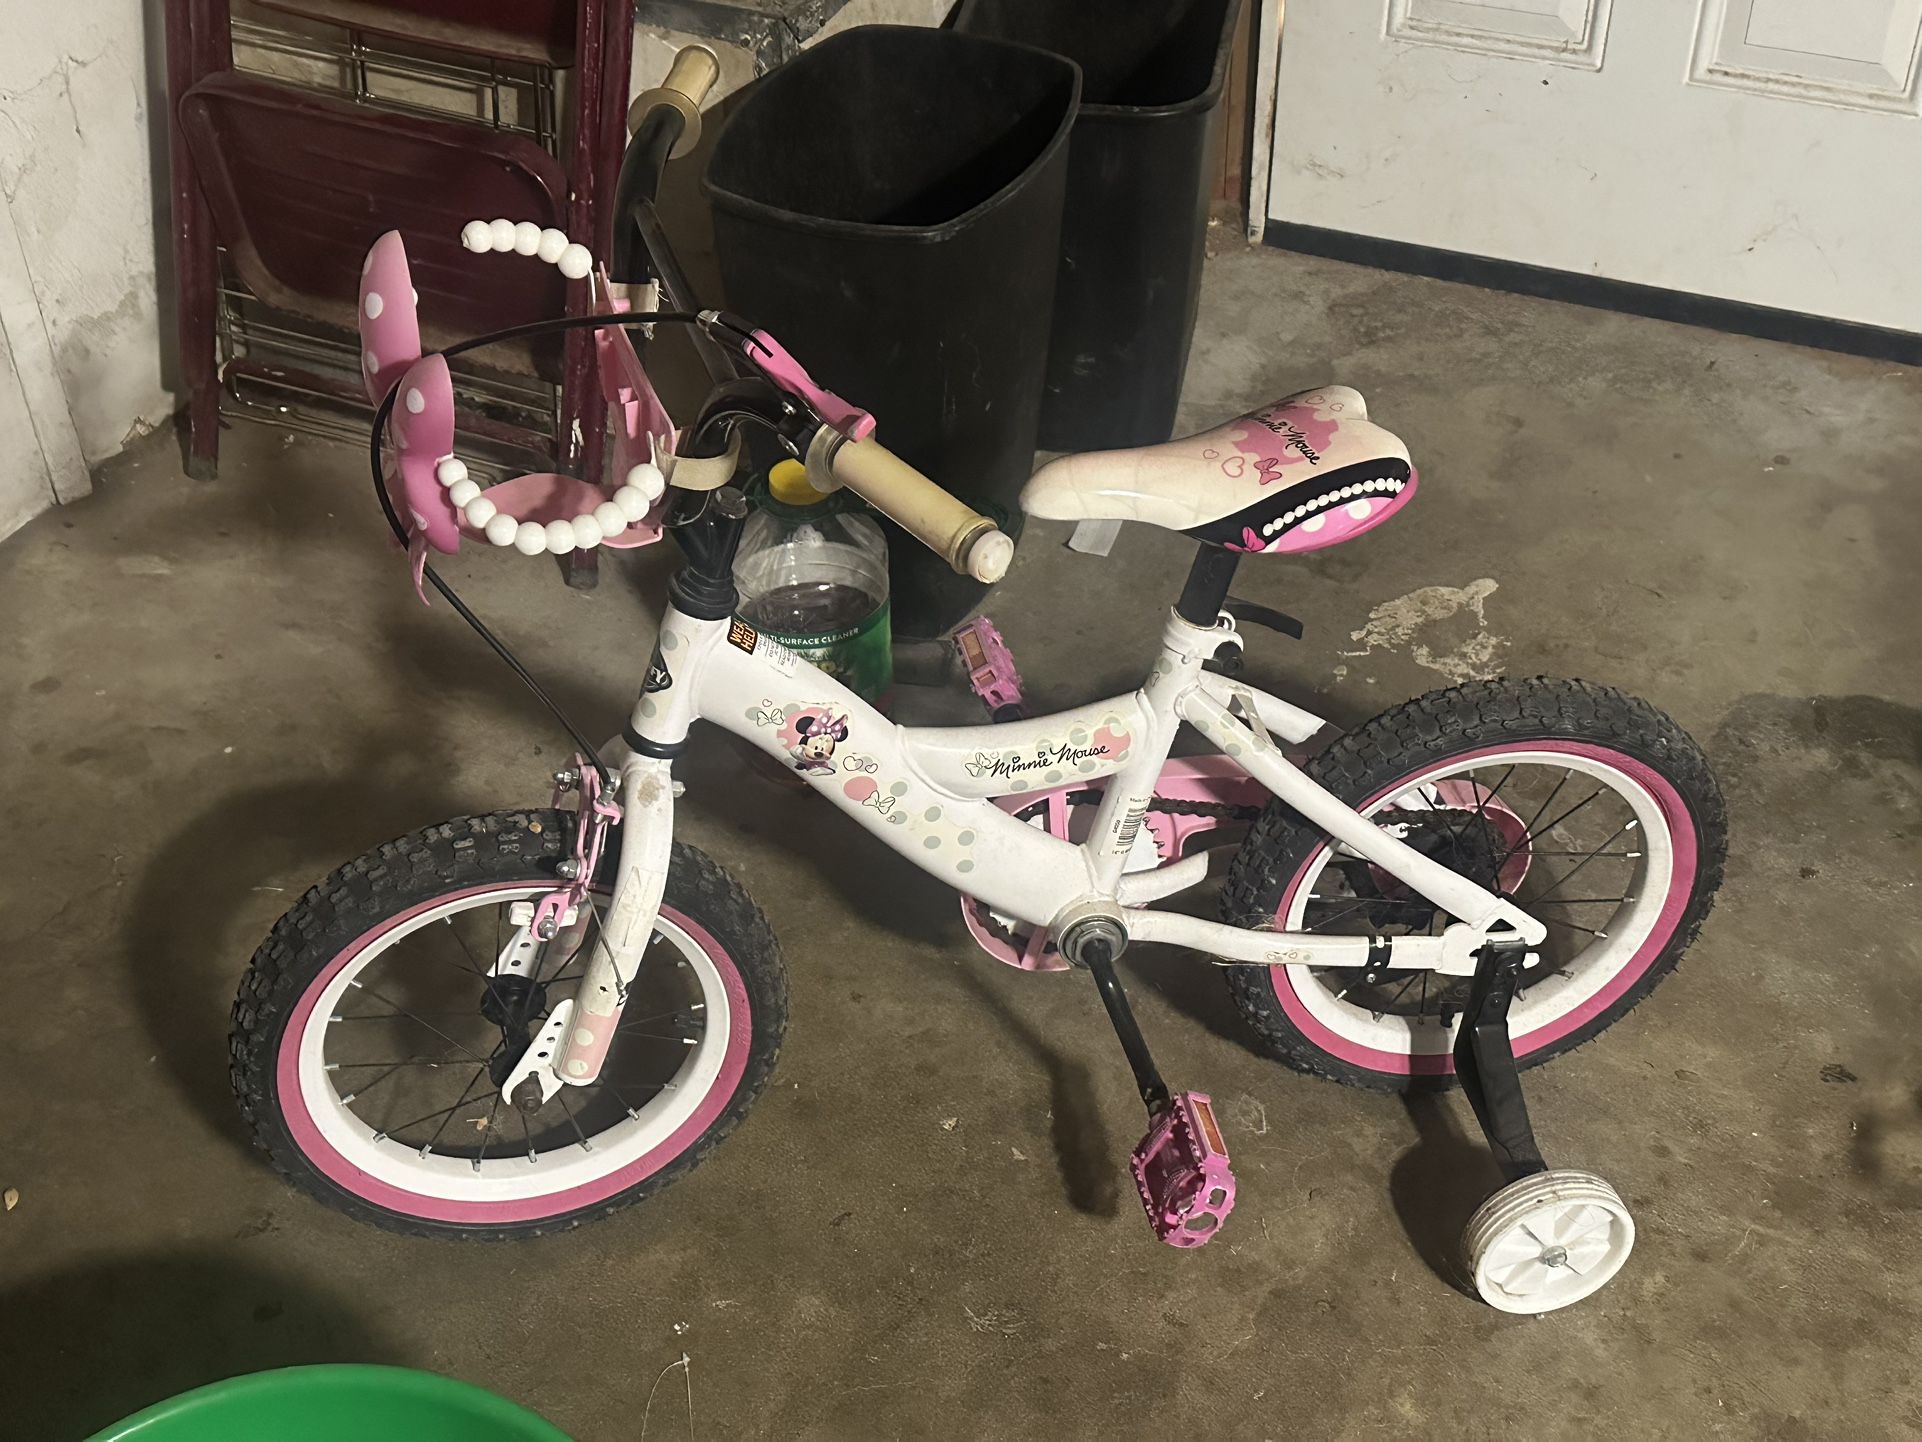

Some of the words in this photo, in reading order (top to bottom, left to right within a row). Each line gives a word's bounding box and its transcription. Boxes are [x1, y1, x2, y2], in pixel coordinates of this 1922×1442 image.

[1281, 426, 1321, 466] Mouse
[729, 618, 746, 643] WEA
[821, 627, 859, 644] CLEANER
[984, 750, 1053, 779] Minnie
[1050, 742, 1110, 766] Mouse
